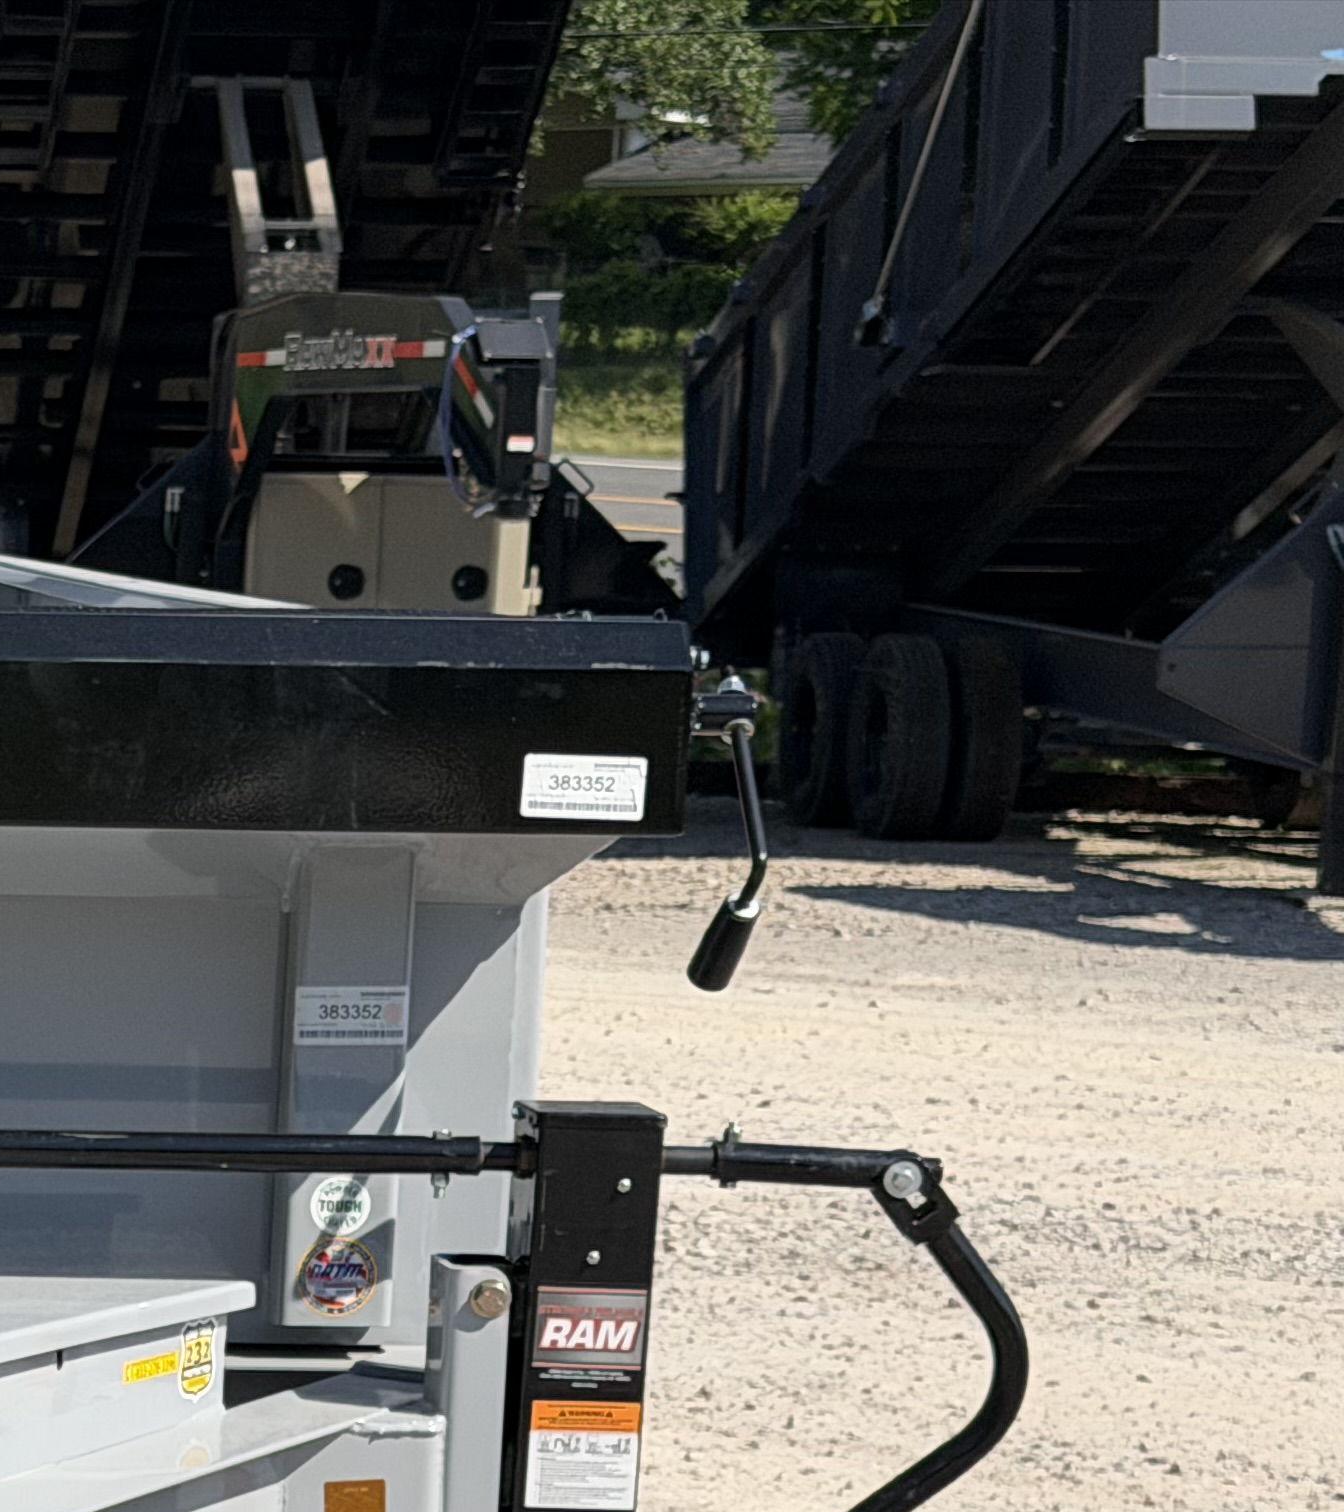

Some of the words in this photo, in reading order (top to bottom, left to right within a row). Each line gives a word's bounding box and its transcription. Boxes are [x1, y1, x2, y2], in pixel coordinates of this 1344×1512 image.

[547, 774, 616, 793] 383352
[318, 1003, 382, 1020] 383352
[538, 1317, 639, 1352] RAM
